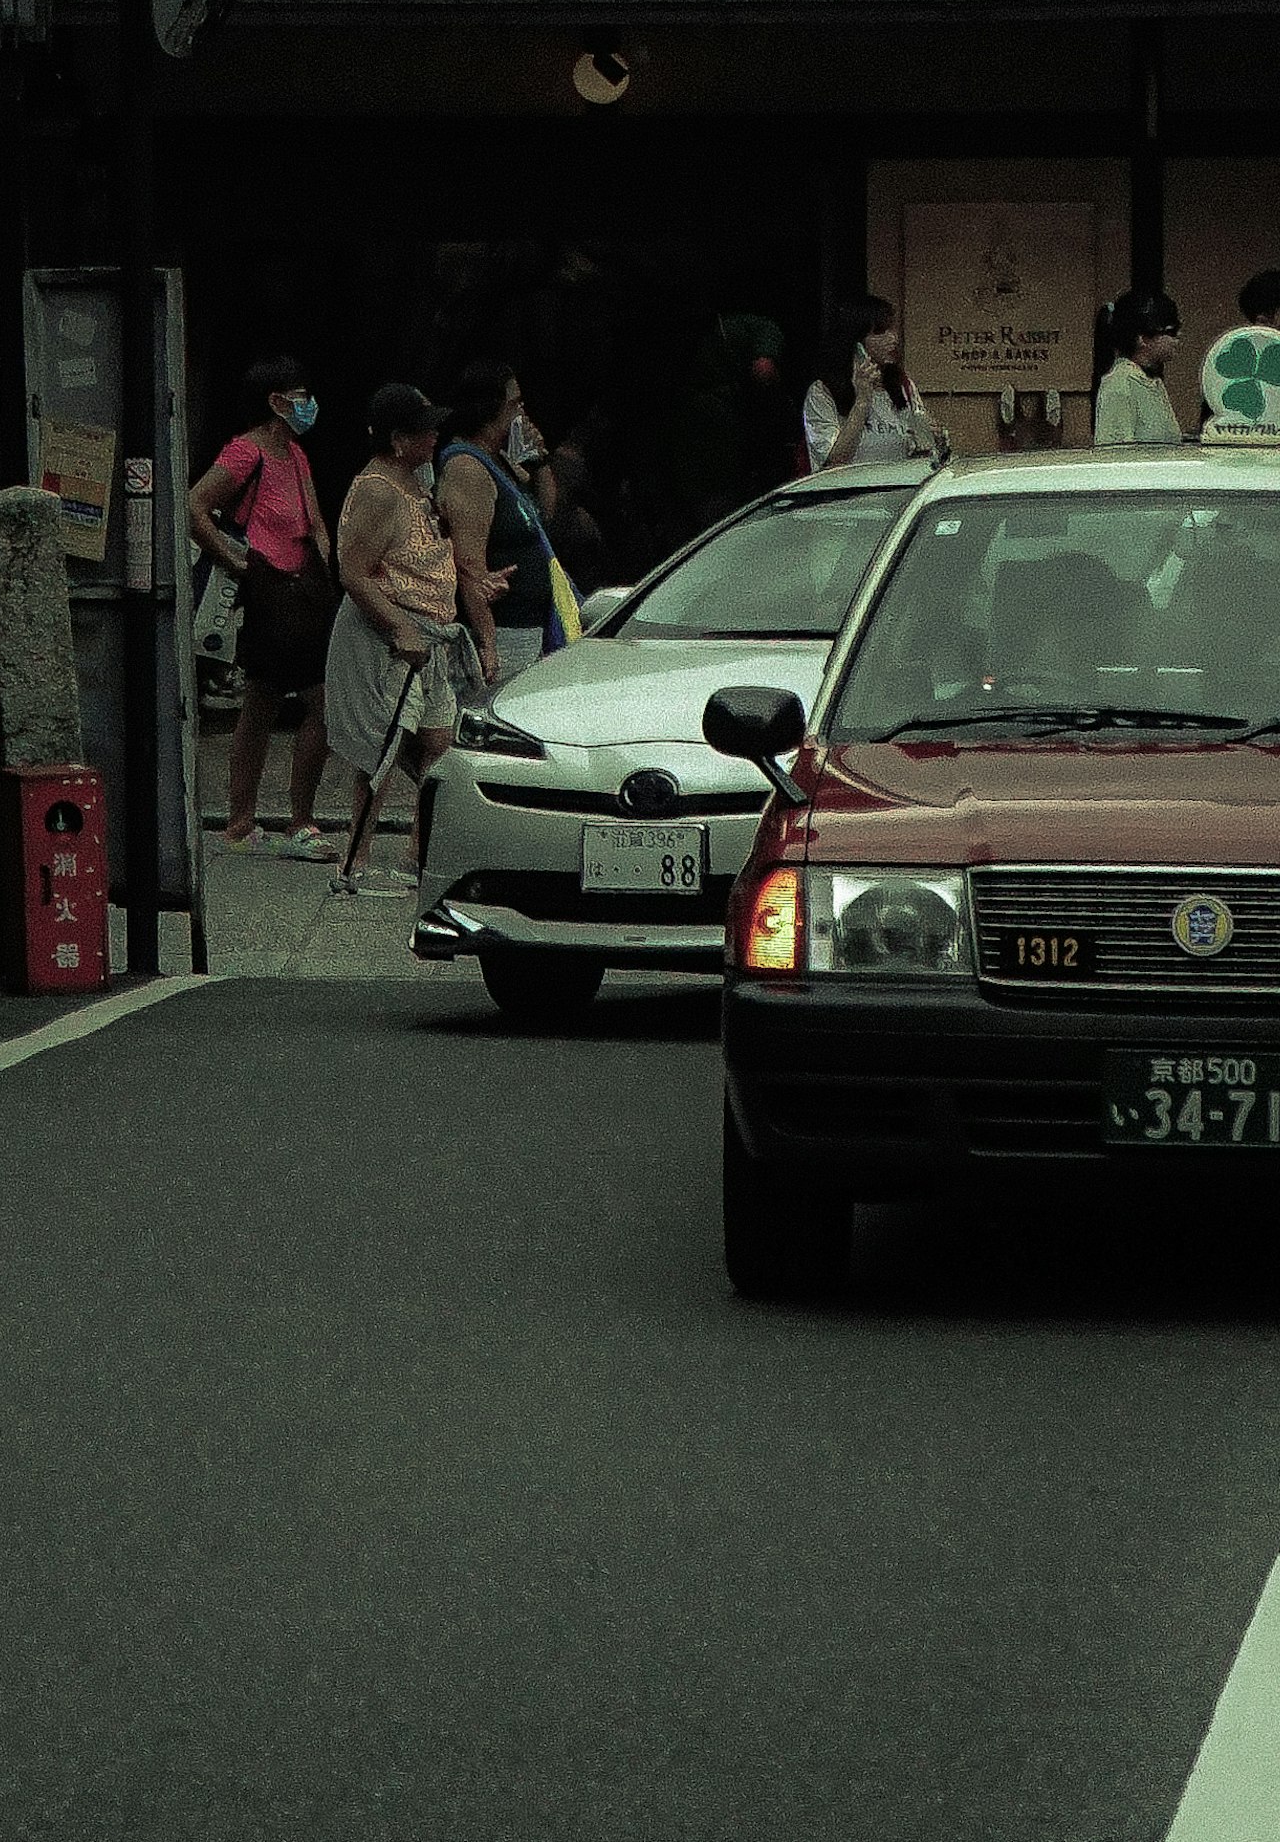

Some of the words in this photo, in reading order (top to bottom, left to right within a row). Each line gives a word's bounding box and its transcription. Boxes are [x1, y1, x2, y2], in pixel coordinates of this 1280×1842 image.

[50, 852, 81, 969] 消火器
[1016, 936, 1080, 967] 1312
[1144, 1088, 1280, 1142] 34-71
